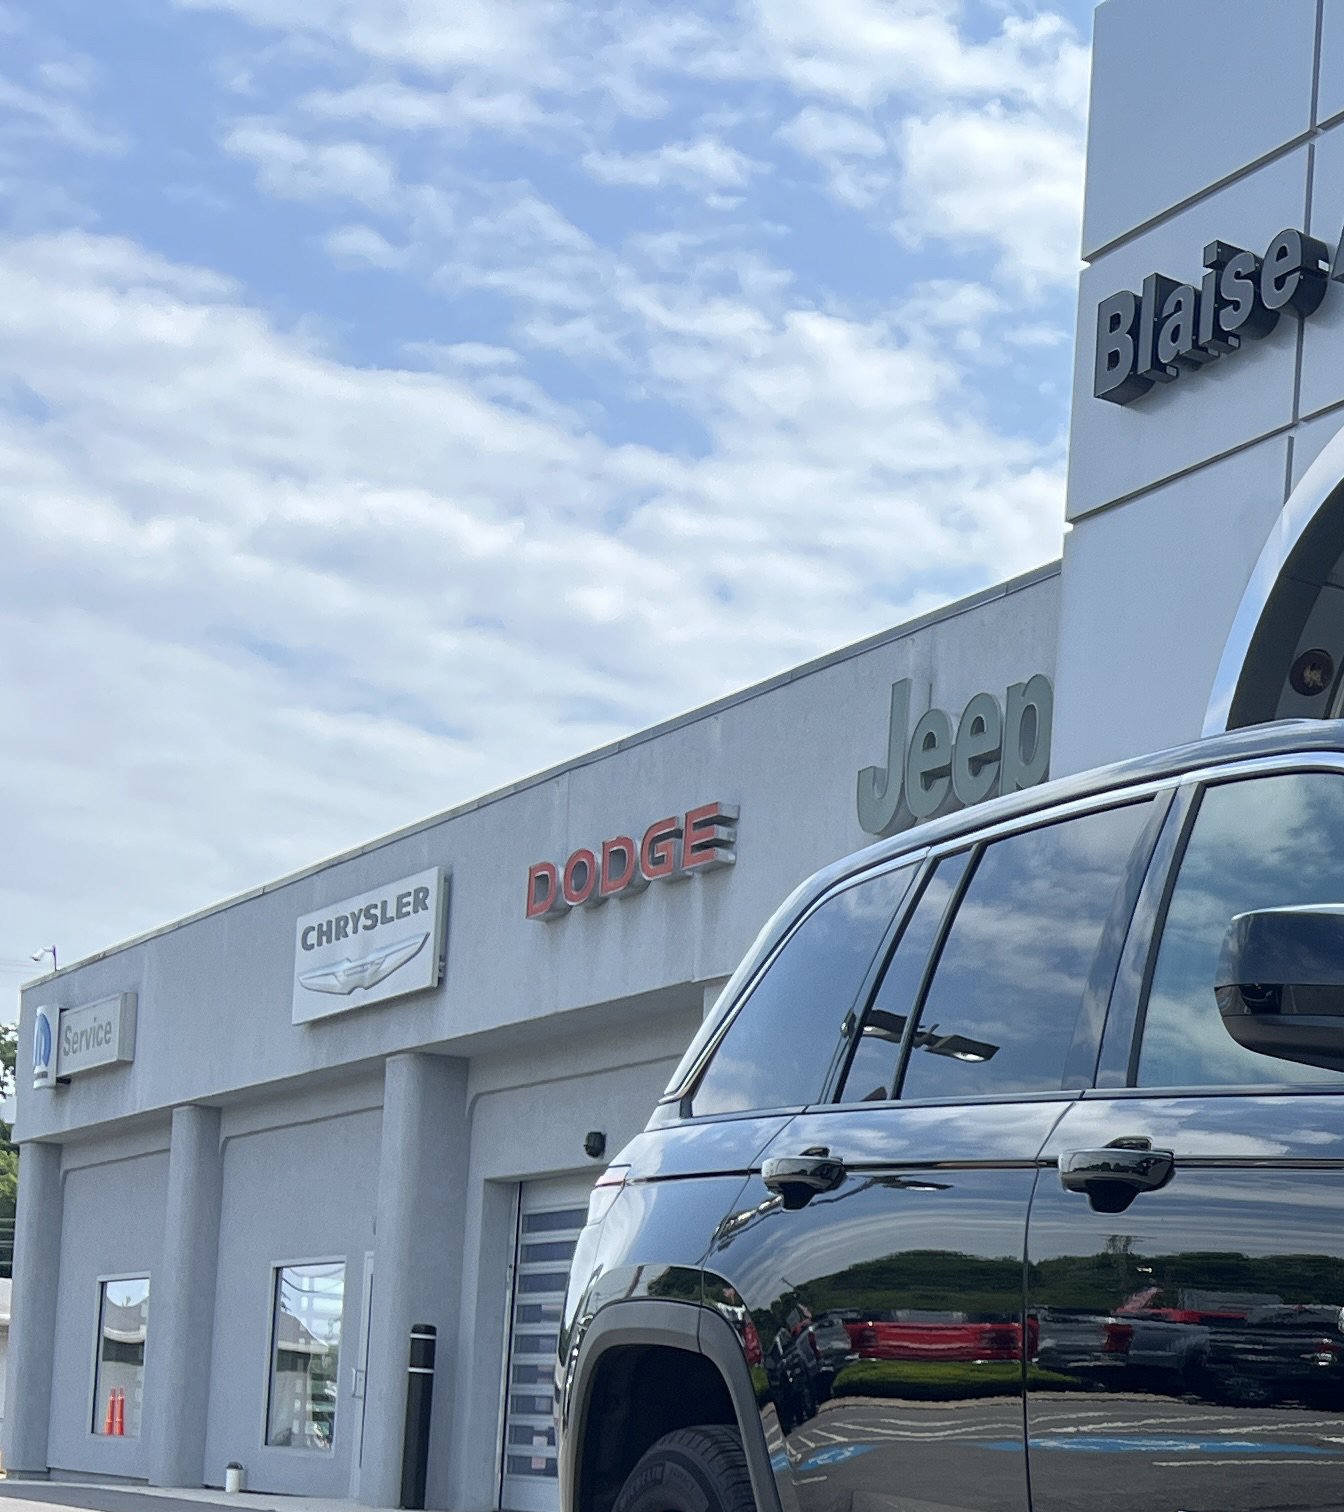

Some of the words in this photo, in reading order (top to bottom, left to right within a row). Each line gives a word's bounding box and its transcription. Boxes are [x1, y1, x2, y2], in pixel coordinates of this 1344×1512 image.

[1094, 228, 1328, 403] Blaise
[857, 674, 1053, 835] Jeep
[301, 886, 430, 951] CHRYSLER
[526, 802, 738, 920] DODGE
[63, 1017, 112, 1056] Service
